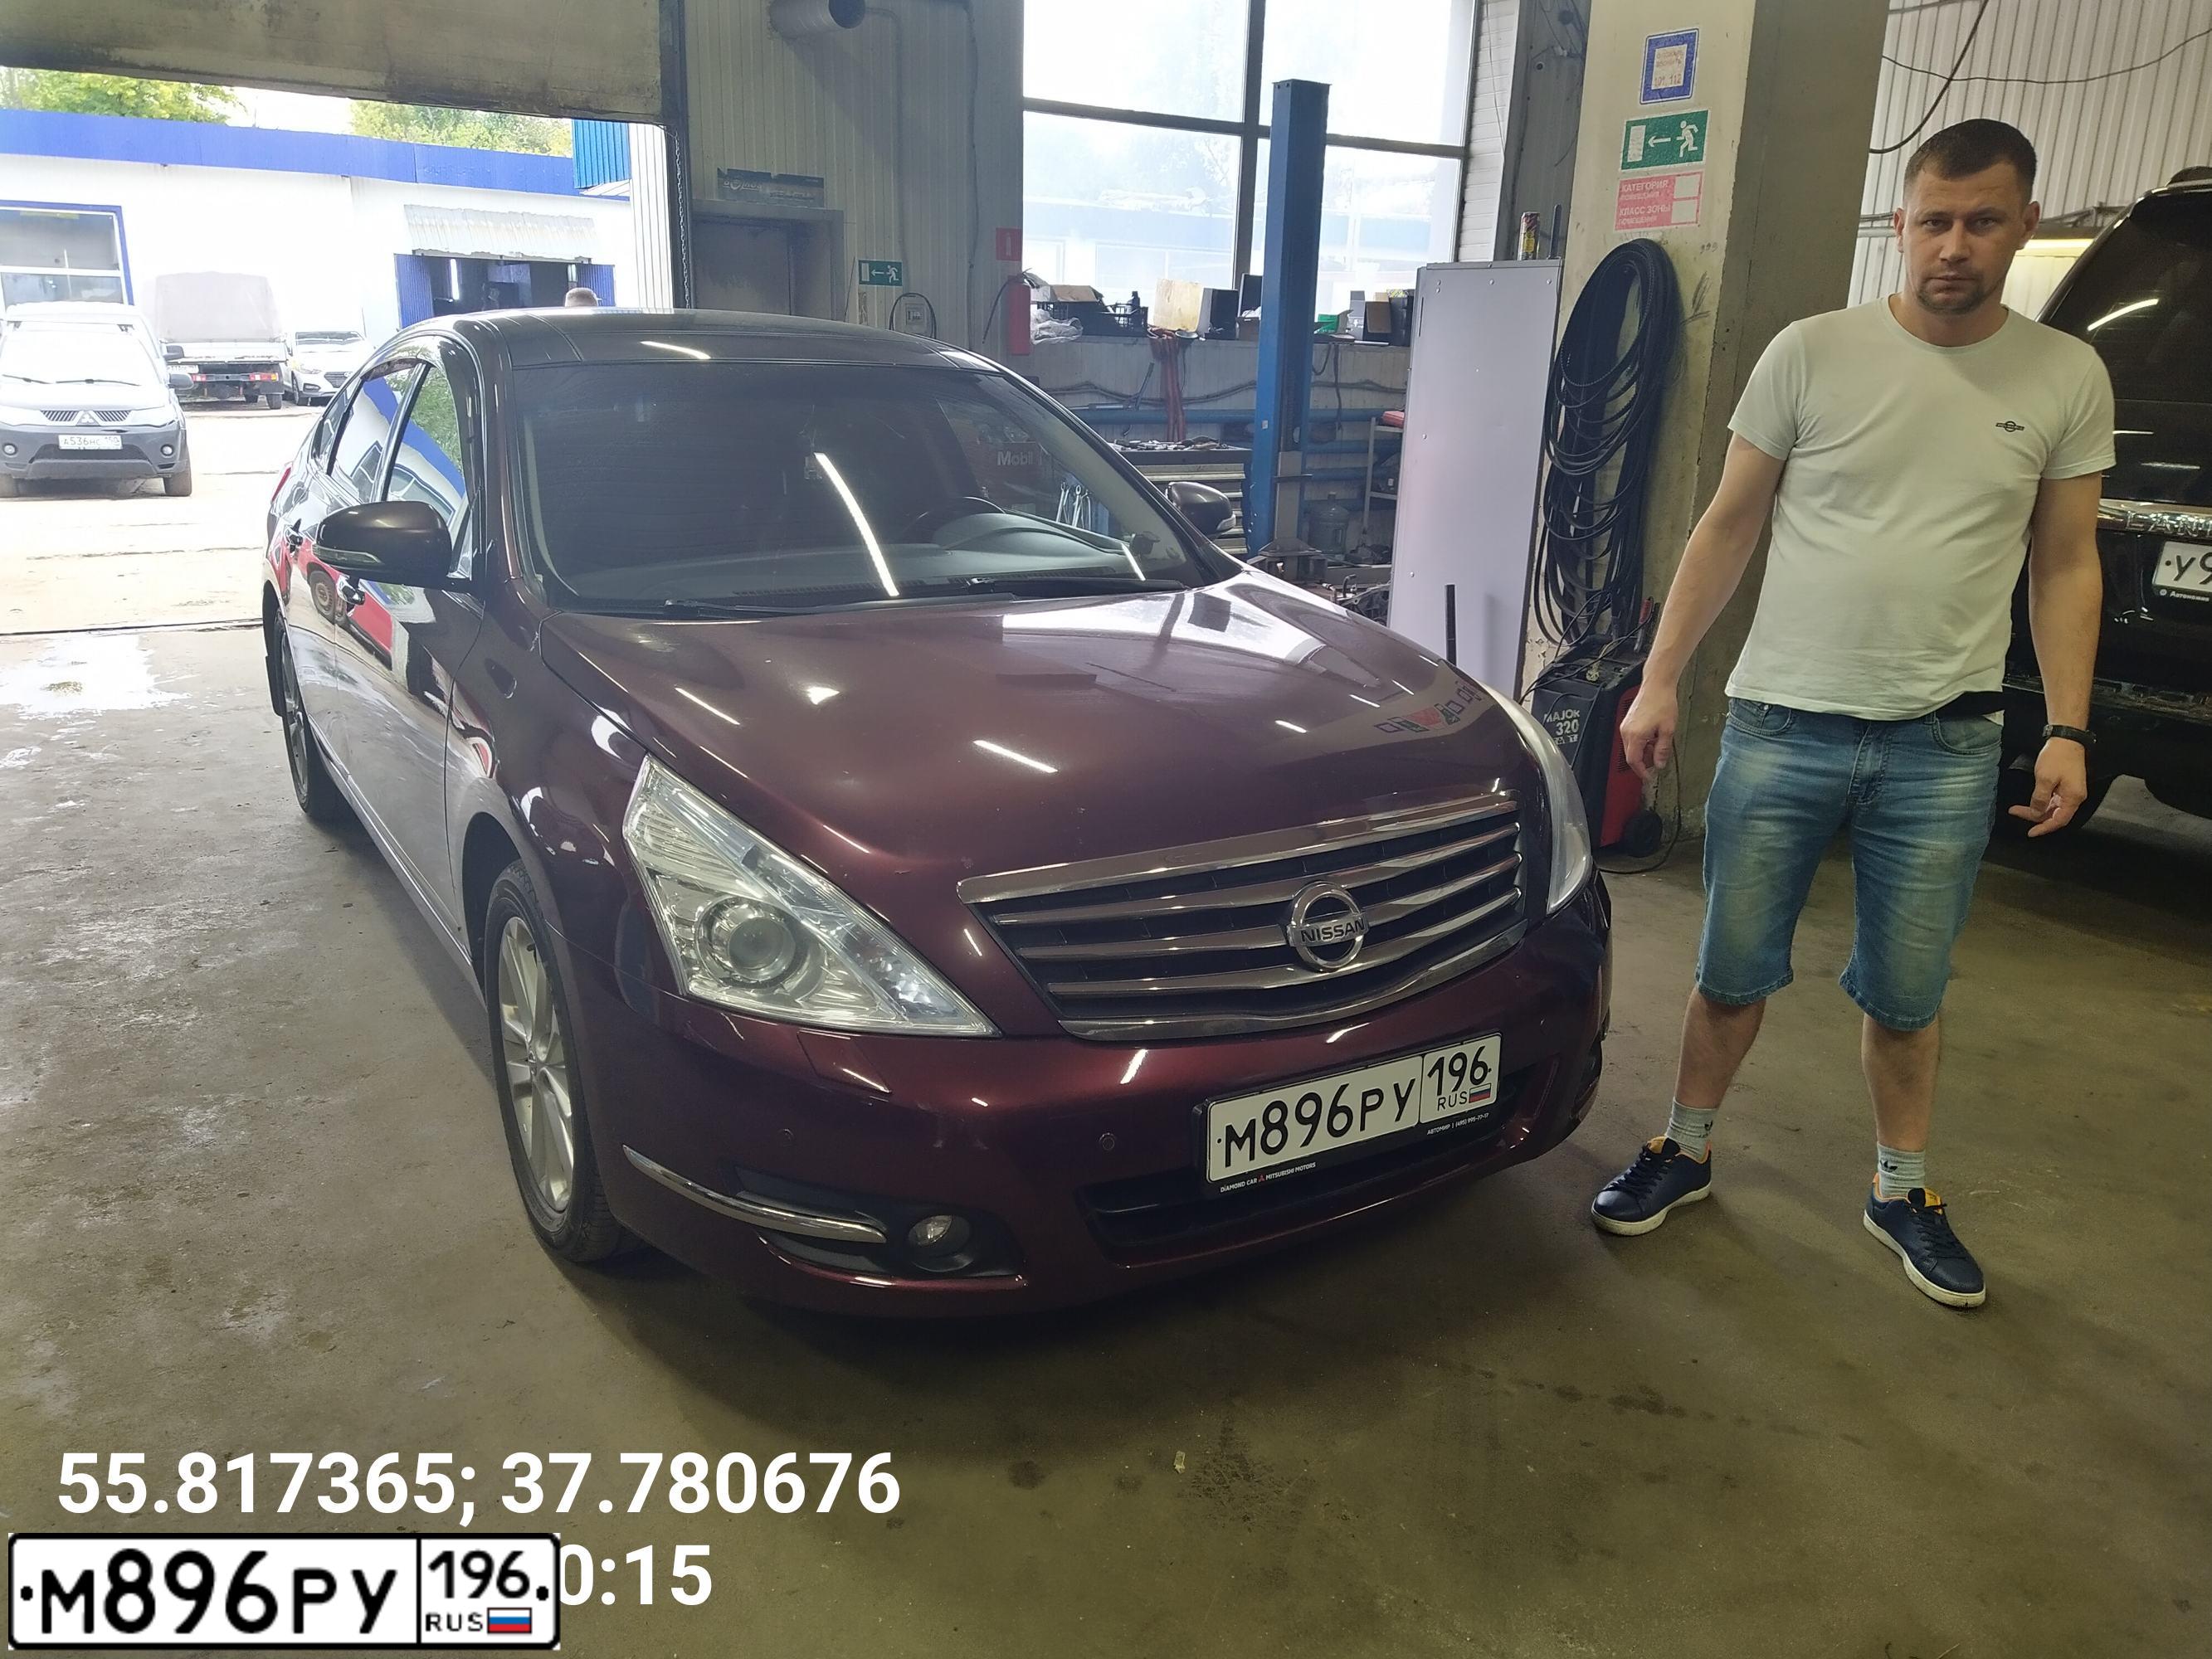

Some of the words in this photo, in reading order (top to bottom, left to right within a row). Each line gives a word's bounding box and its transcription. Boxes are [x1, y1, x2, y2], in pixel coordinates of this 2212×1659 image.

[1620, 180, 1669, 192] КАТЕГОРИЯ
[1619, 206, 1645, 216] КЛАСС
[1647, 204, 1671, 213] ЗОНЫ
[996, 450, 1034, 465] Mobil
[2127, 510, 2212, 538] LAN
[1556, 718, 1580, 736] 320
[1300, 919, 1365, 942] NISSAN
[1224, 1078, 1416, 1168] М896РУ
[1427, 1045, 1488, 1097] 196
[1437, 1090, 1468, 1112] RUS
[1246, 1178, 1258, 1187] CAR
[1265, 1169, 1295, 1181] MITSUBISHI
[1295, 1162, 1317, 1173] MOTORS
